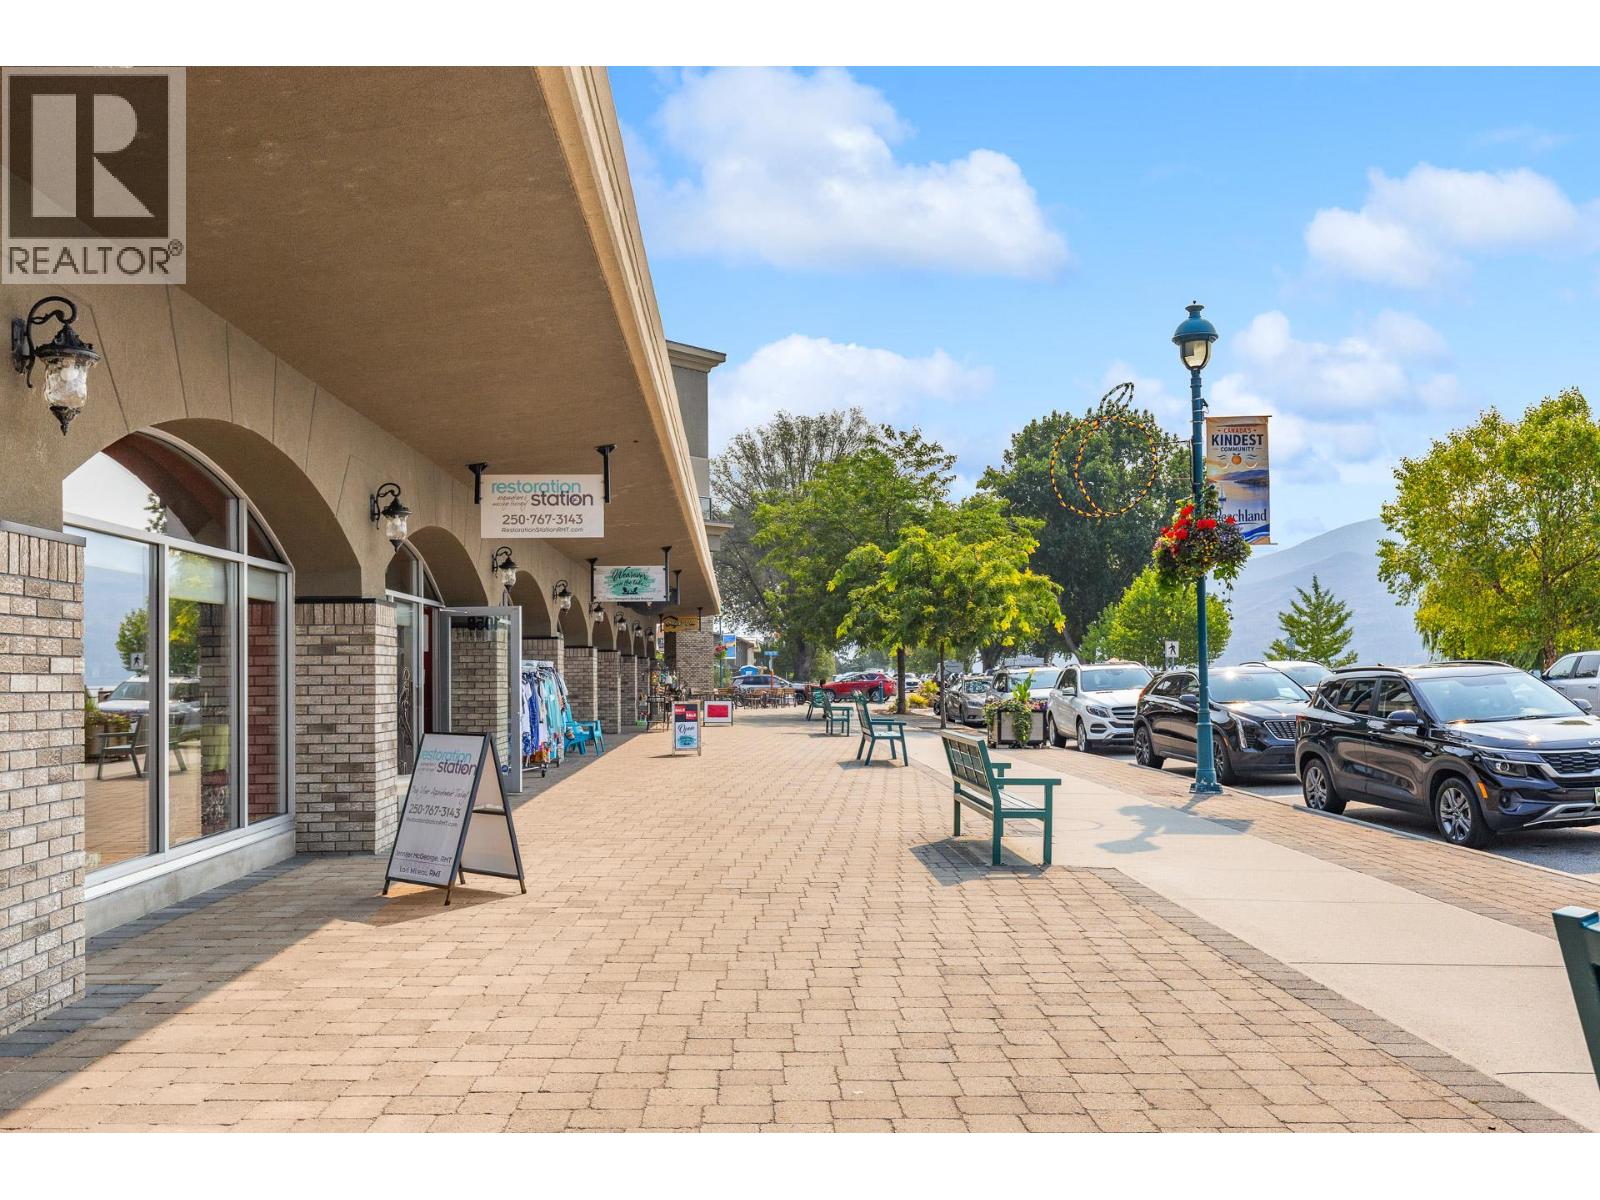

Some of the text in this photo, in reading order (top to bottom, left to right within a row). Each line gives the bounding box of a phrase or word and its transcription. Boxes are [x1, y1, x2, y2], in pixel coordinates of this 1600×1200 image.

[1211, 434, 1264, 446] KINDEST
[491, 480, 581, 494] restoration
[531, 491, 594, 506] station
[502, 514, 584, 525] 250-767-3143
[677, 724, 695, 735] Open
[436, 760, 478, 777] station
[408, 803, 462, 819] 250-767-3143
